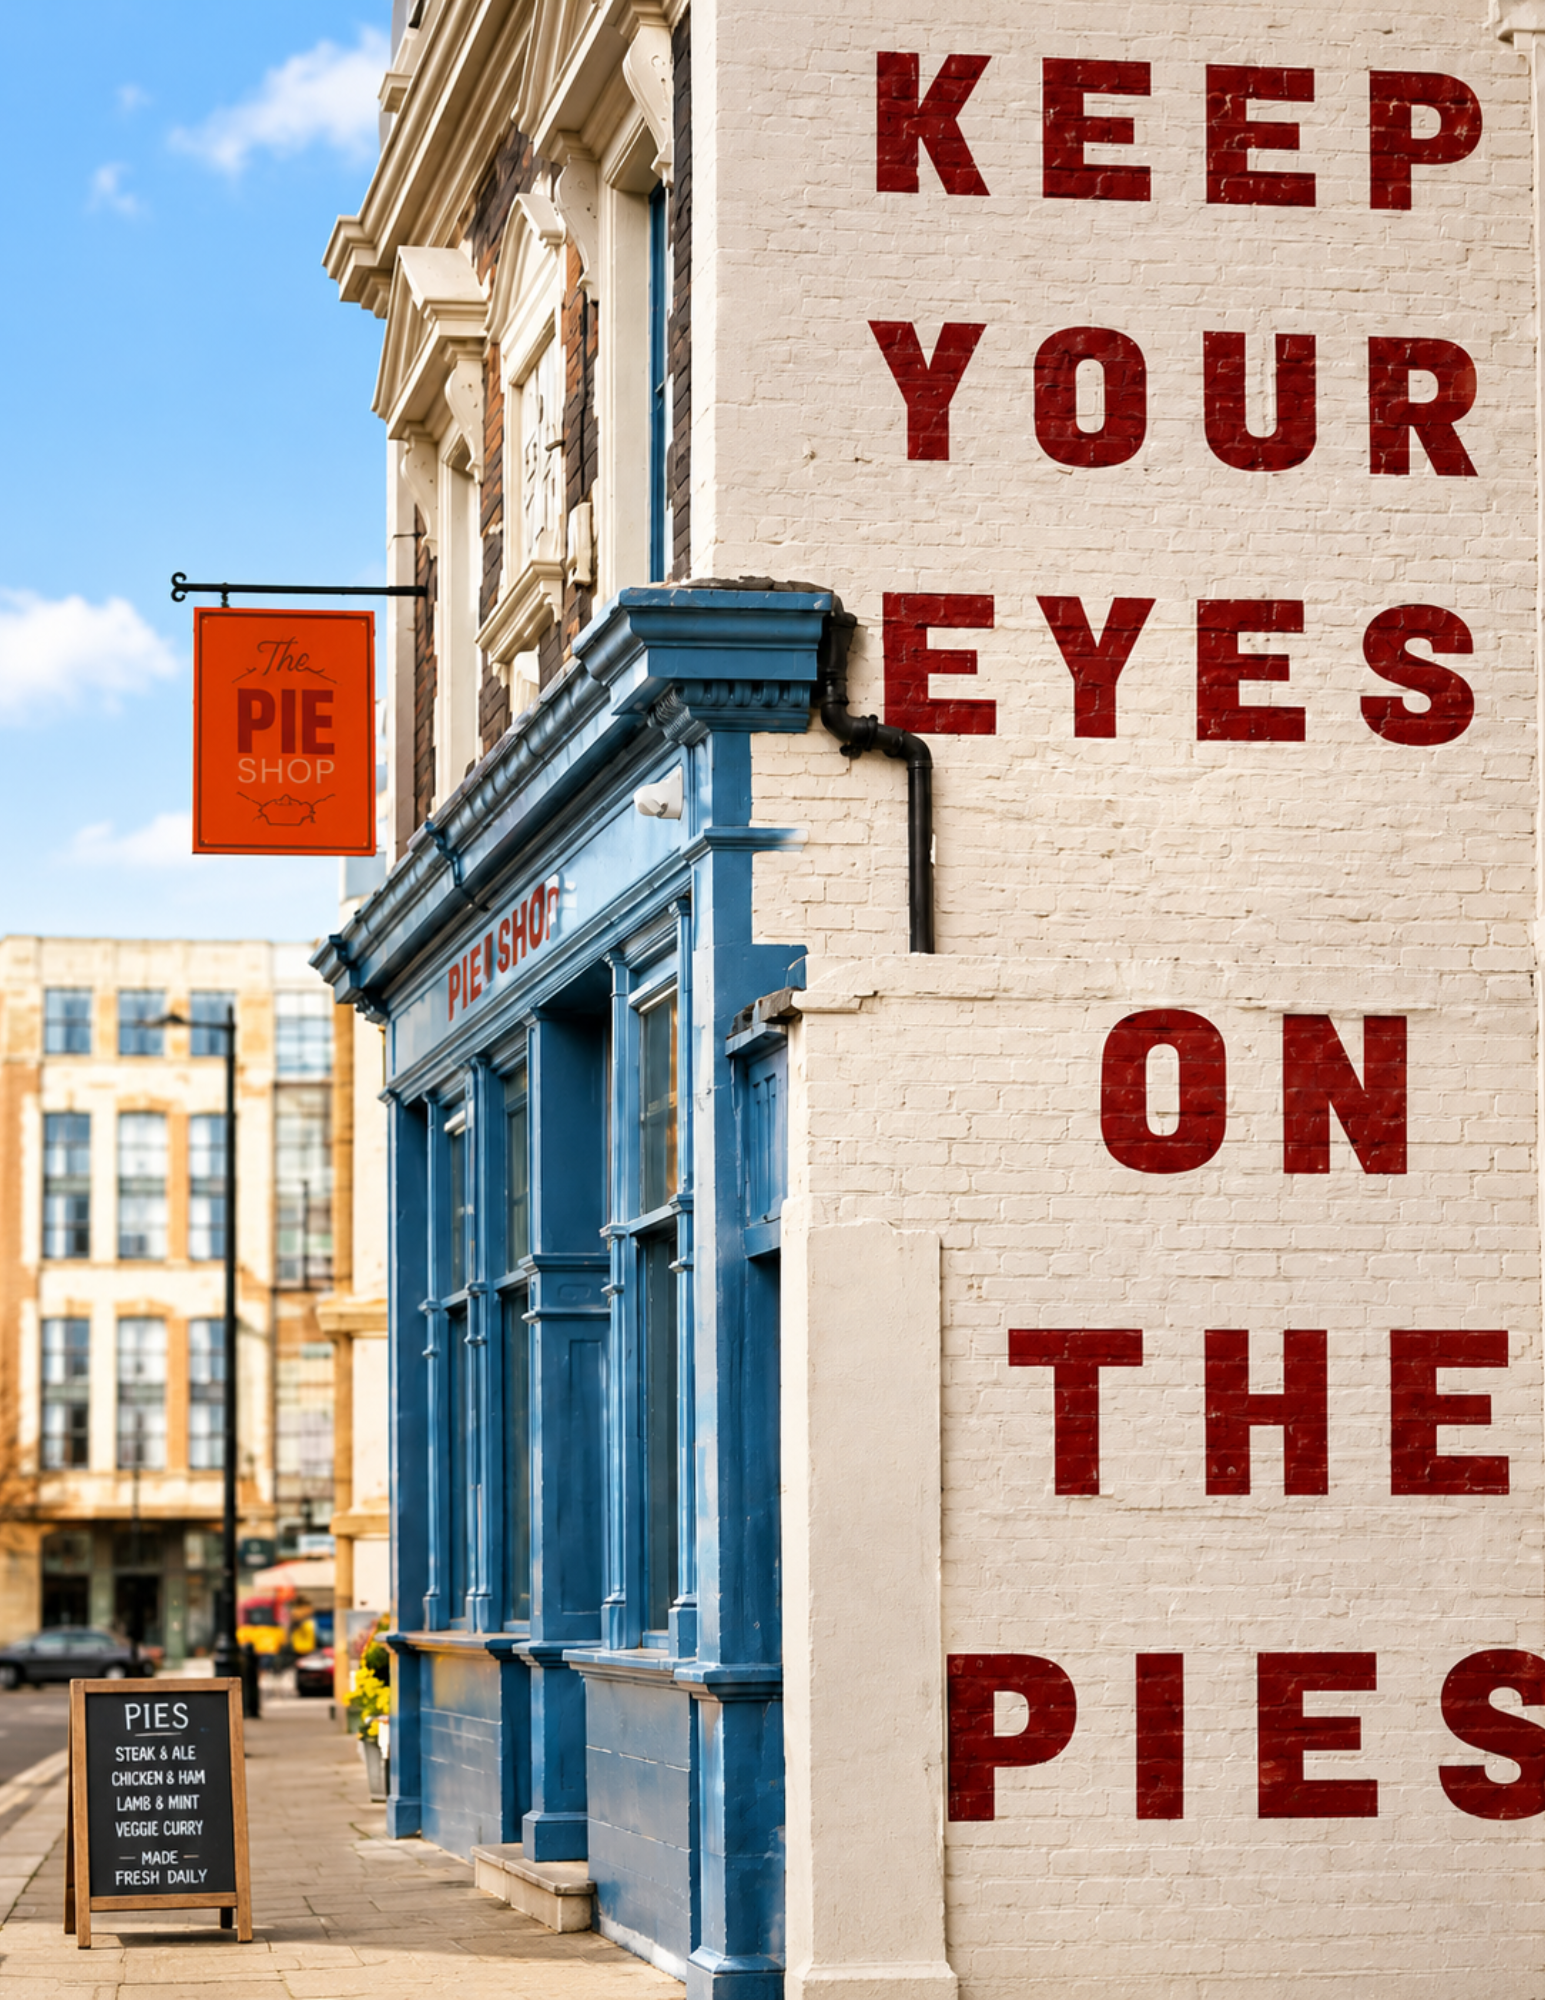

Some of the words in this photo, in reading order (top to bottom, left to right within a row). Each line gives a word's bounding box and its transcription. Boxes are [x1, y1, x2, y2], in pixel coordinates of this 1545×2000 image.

[877, 52, 1482, 210] KEEP
[868, 321, 1477, 476] YOUR
[256, 636, 323, 676] The
[883, 592, 1474, 746] EYES
[237, 688, 335, 755] PIE
[237, 757, 335, 784] SHOP
[1101, 1009, 1407, 1174] ON
[1008, 1329, 1509, 1495] THE
[124, 1702, 190, 1731] PIES
[947, 1650, 1545, 1821] PIES
[115, 1745, 156, 1762] STEAK
[171, 1745, 197, 1761] ALE
[111, 1770, 163, 1787] CHICKEN
[178, 1769, 206, 1785] HAM
[116, 1795, 152, 1812] LAMB
[168, 1794, 200, 1810] MINT
[115, 1820, 159, 1838] VEGGIE
[163, 1819, 204, 1836] CURRY
[141, 1849, 179, 1866] MADE
[115, 1869, 160, 1886] FRESH
[167, 1868, 208, 1885] DAILY
